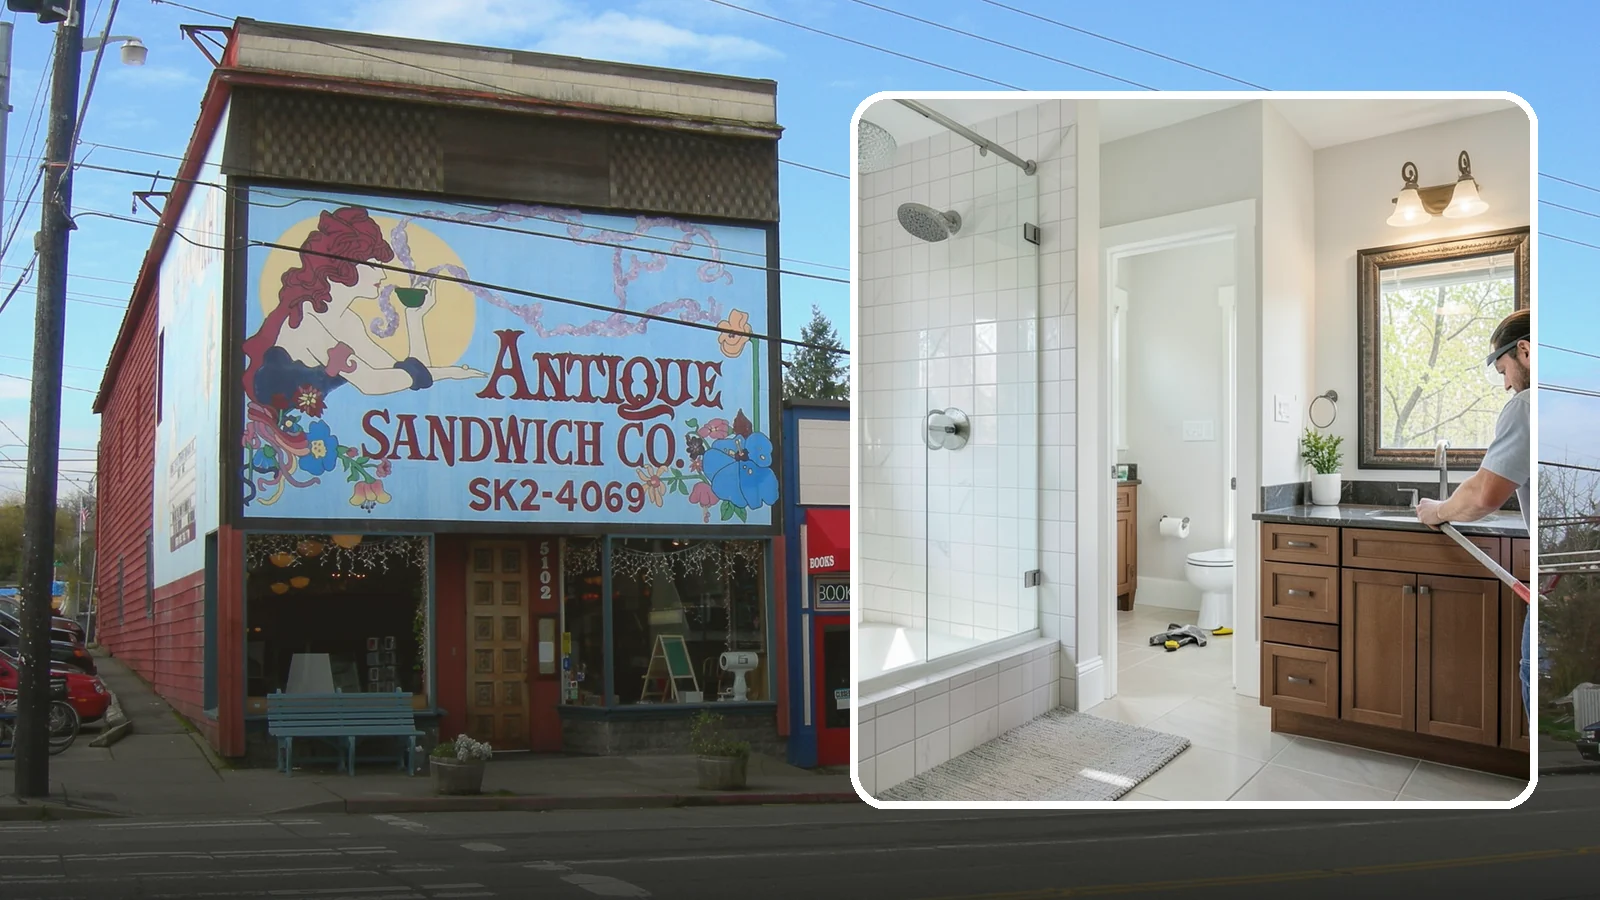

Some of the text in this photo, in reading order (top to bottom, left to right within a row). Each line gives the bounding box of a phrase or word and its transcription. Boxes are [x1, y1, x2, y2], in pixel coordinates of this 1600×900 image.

[476, 329, 724, 421] ANTIQUE
[361, 408, 685, 469] SANDWICH CO.
[469, 477, 645, 513] SK2-4069
[540, 541, 551, 600] 5102
[809, 555, 835, 569] BOOKS
